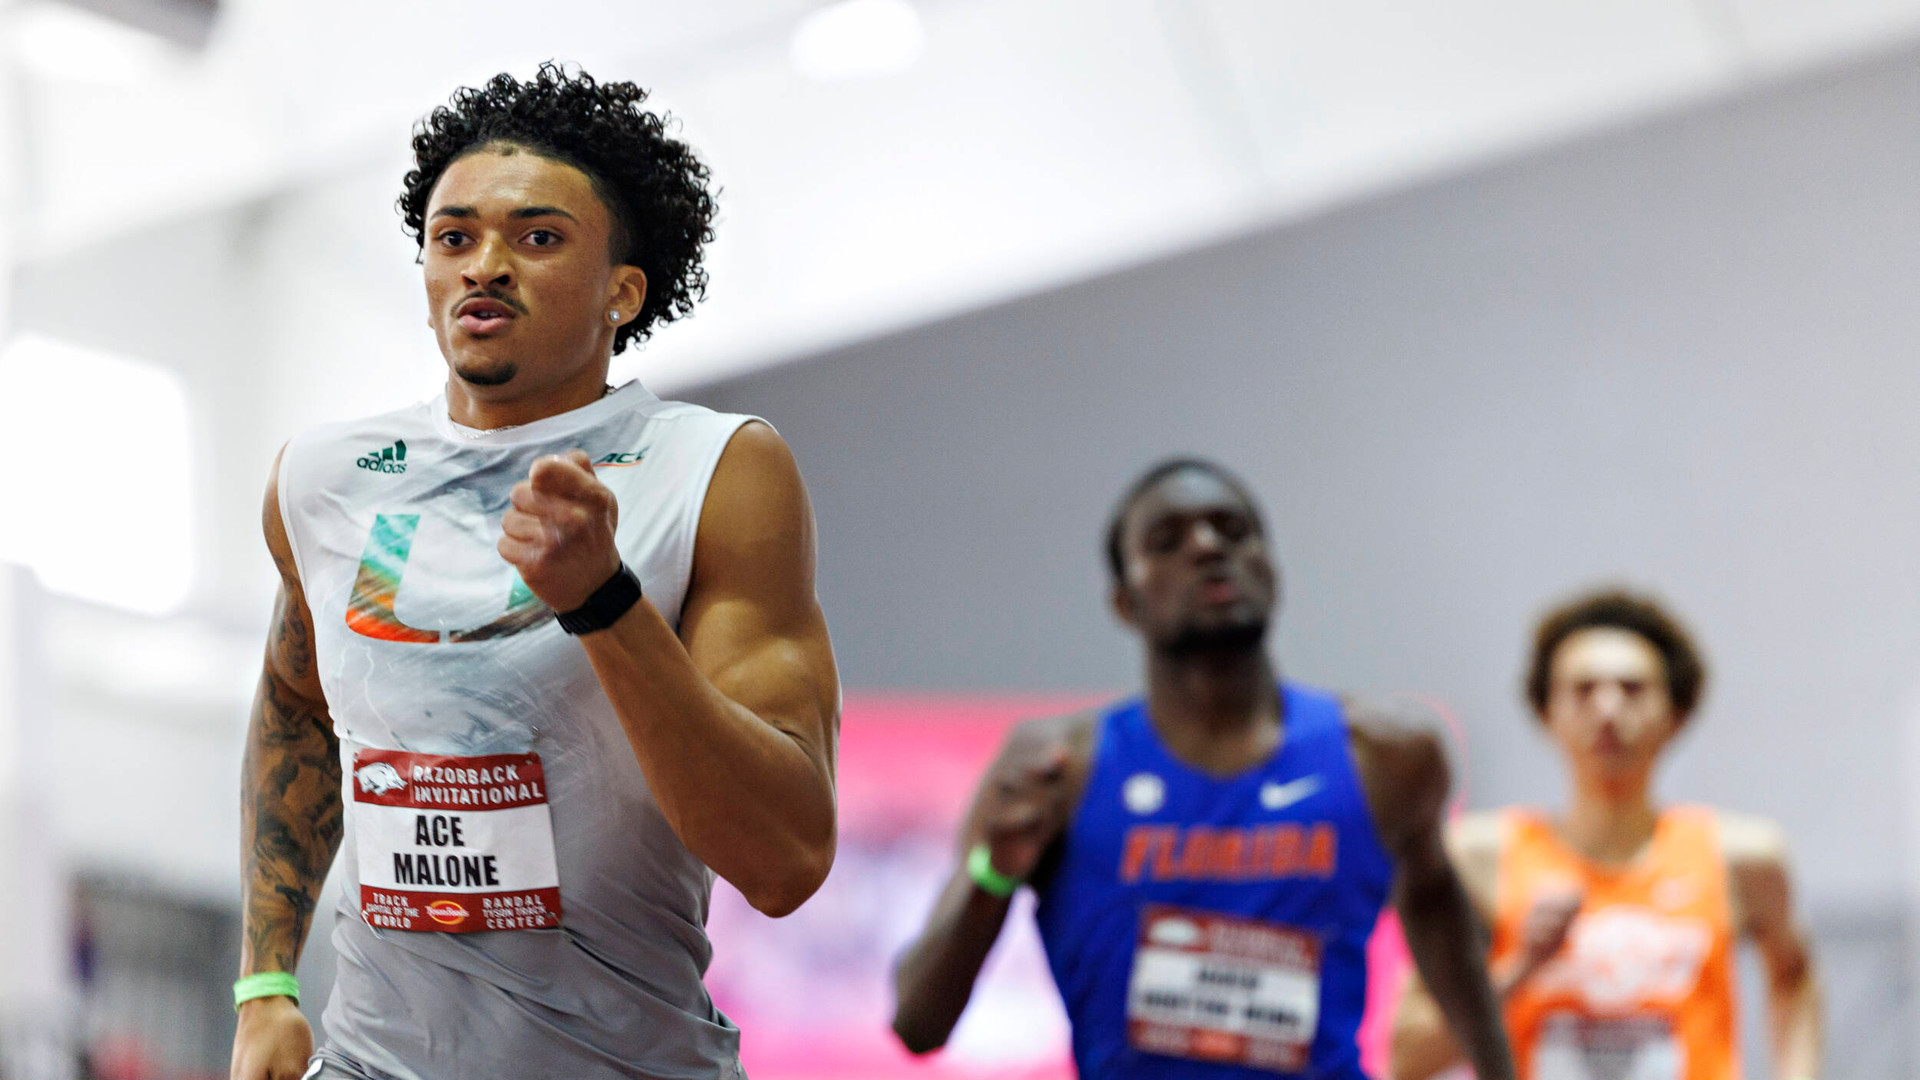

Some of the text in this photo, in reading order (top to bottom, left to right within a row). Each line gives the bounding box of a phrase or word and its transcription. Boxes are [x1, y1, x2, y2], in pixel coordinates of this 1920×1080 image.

[413, 764, 520, 785] RAZORBACK
[414, 781, 543, 805] INVITATIONAL
[415, 815, 465, 847] ACE
[1123, 823, 1337, 883] FLORIDA
[393, 853, 499, 887] MALONE
[373, 892, 409, 907] TRACK
[482, 894, 543, 909] RANDAL
[393, 906, 403, 916] OF
[404, 907, 420, 918] THE
[482, 908, 514, 918] TYSON
[373, 914, 411, 929] WORLD
[486, 915, 545, 929] CENTER
